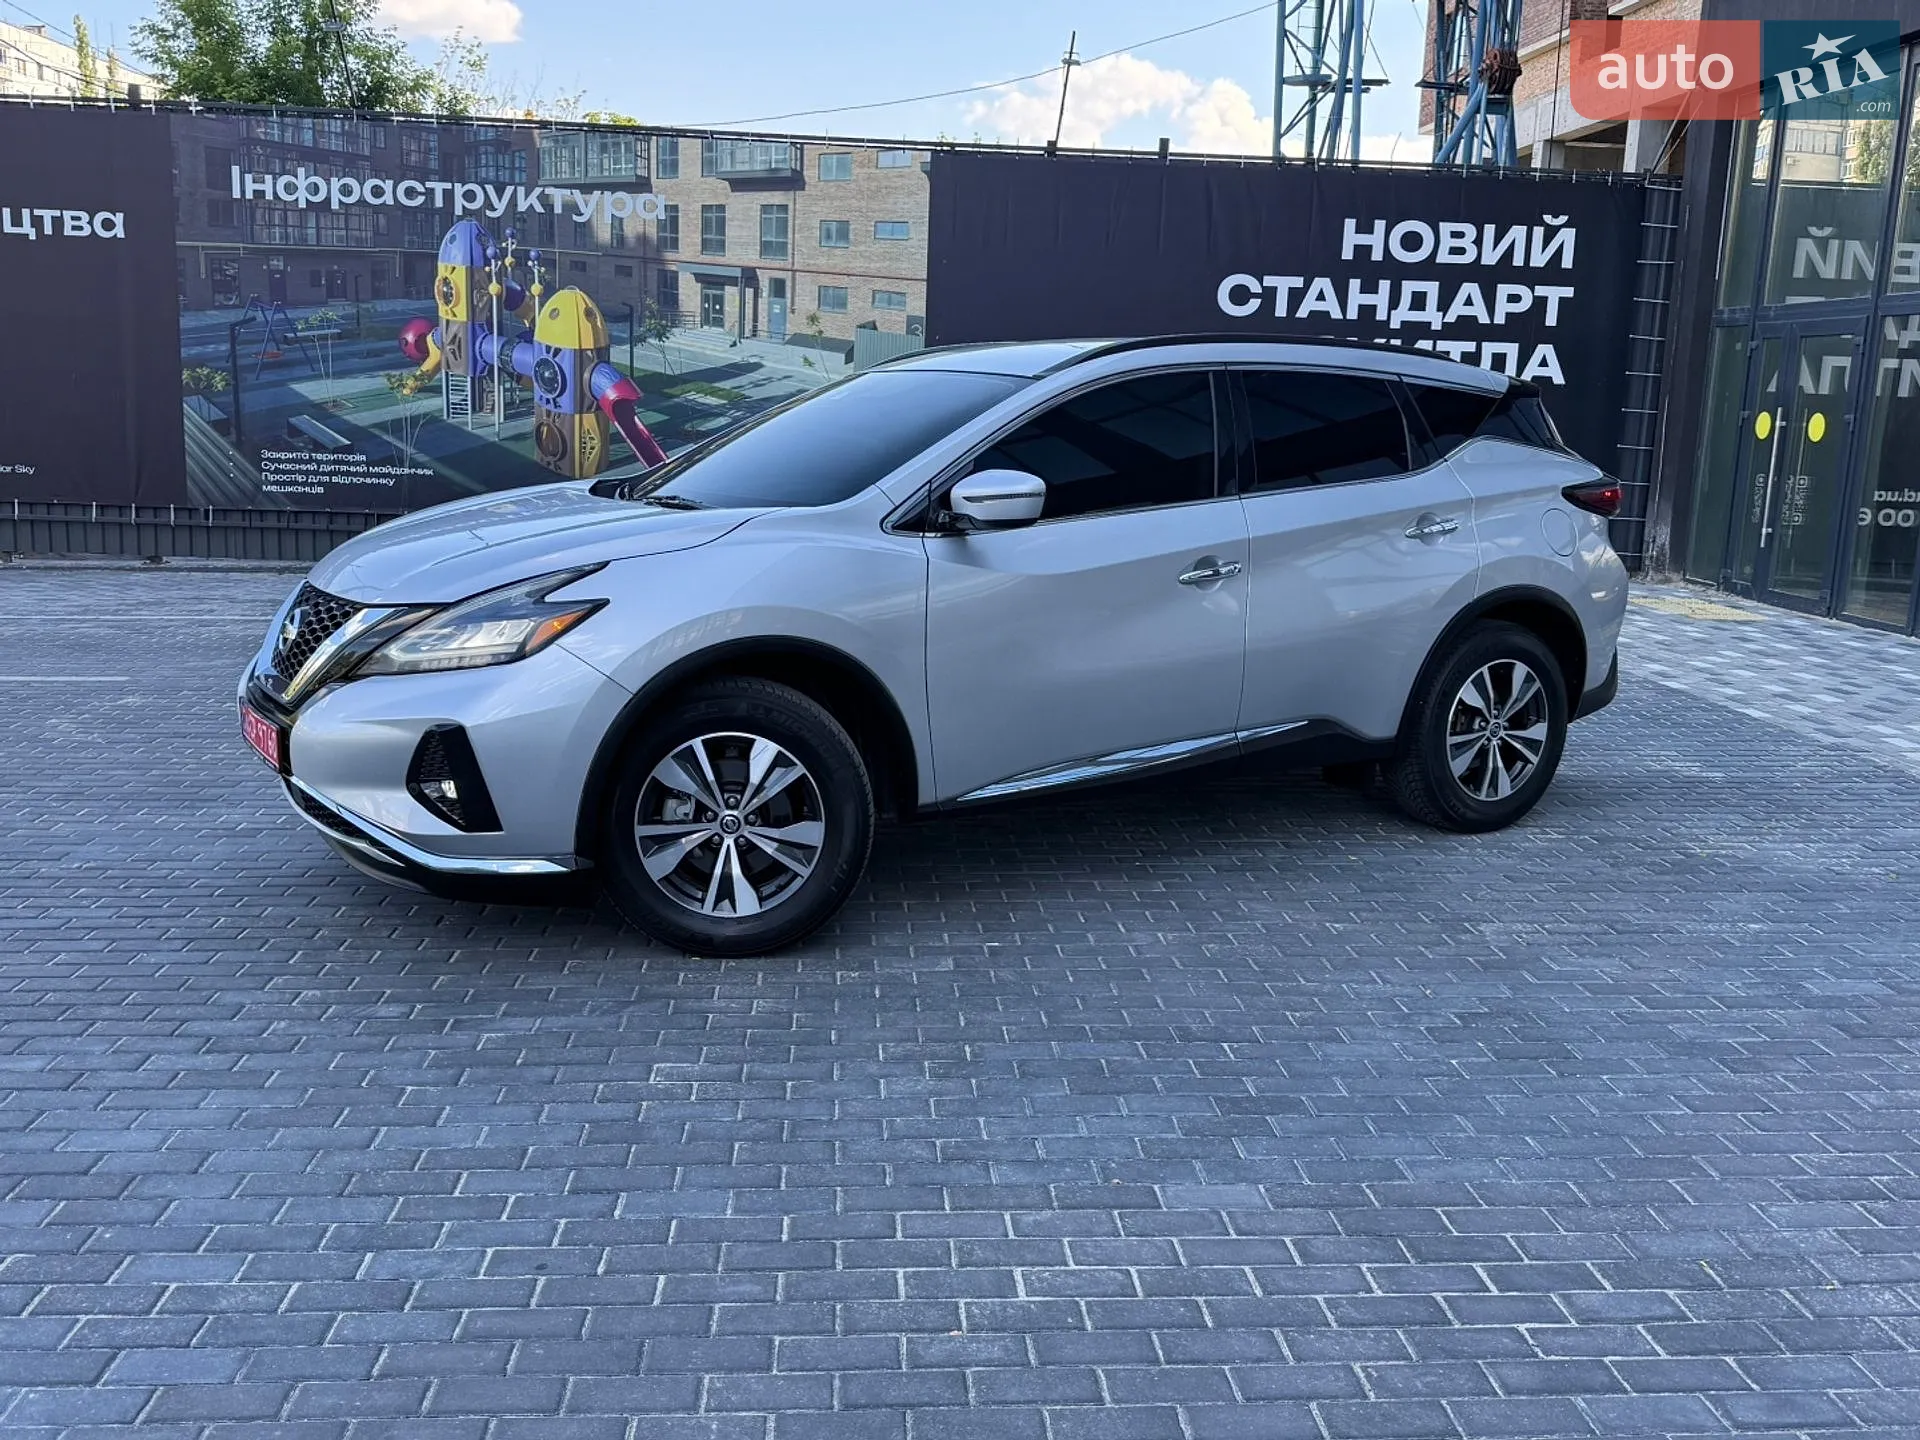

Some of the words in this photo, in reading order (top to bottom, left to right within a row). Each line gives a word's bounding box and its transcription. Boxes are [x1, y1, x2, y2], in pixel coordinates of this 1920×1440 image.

[230, 165, 667, 223] Інфраструктура
[1, 206, 126, 241] цтва
[1340, 214, 1576, 269] НОВИЙ
[1216, 272, 1575, 330] СТАНДАРТ
[260, 449, 310, 460] Закрита
[311, 452, 367, 462] територія
[14, 464, 36, 475] Sky
[261, 461, 318, 471] Сучасний
[319, 464, 368, 473] дитячий
[369, 465, 434, 476] майданчик
[262, 472, 307, 482] Простір
[308, 475, 330, 483] для
[331, 475, 396, 487] відпочинку
[262, 485, 325, 494] мешканців
